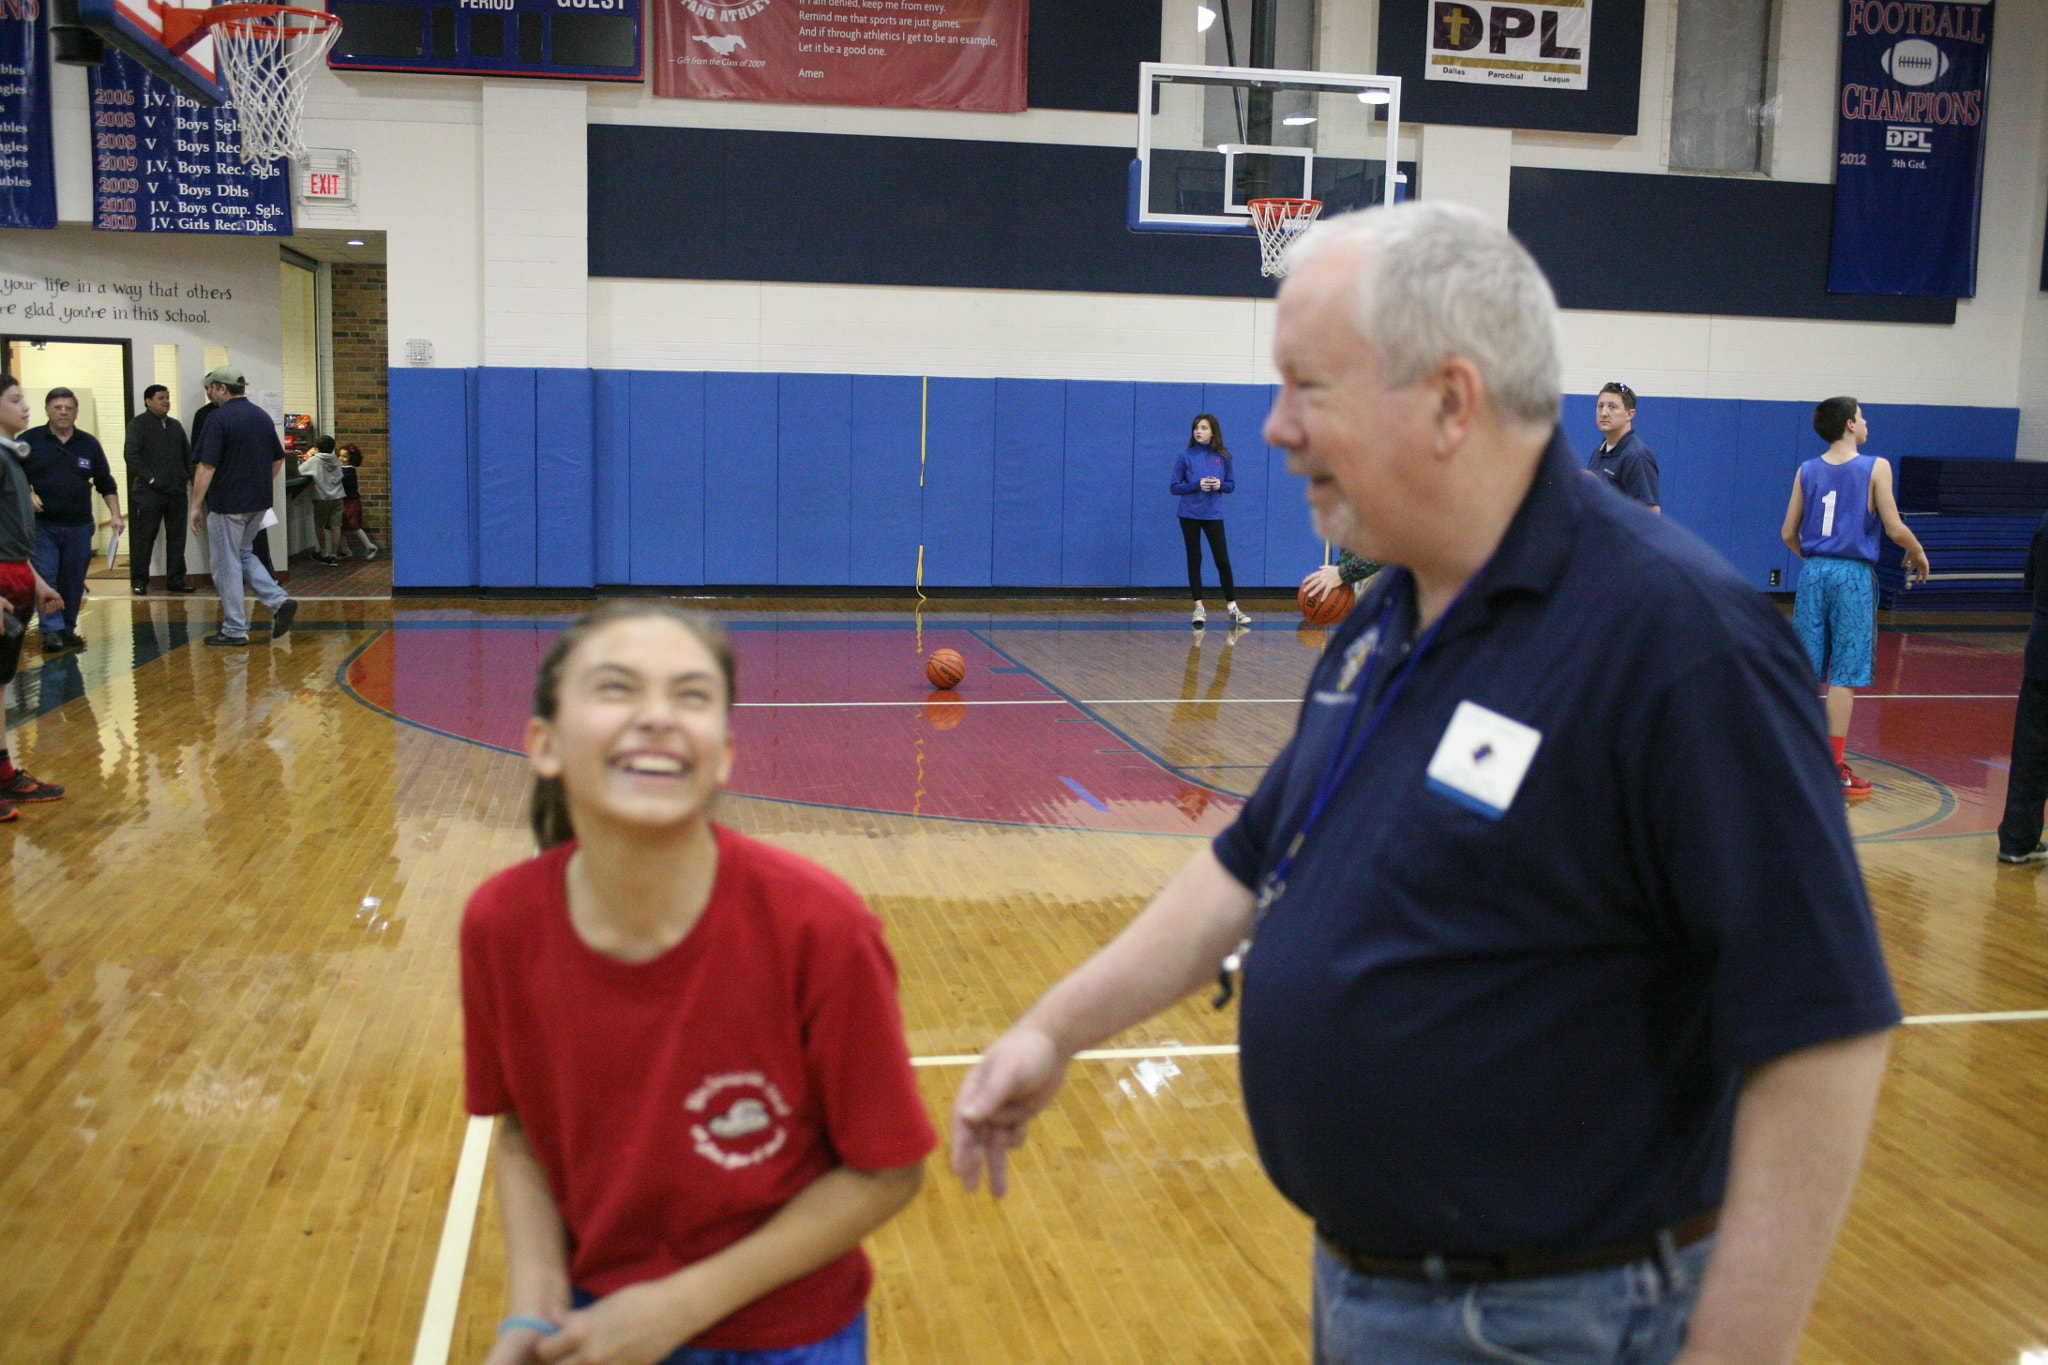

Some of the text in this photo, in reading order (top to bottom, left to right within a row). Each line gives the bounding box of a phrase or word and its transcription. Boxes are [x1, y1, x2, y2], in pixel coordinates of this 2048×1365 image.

[862, 0, 883, 11] keep
[886, 2, 899, 10] me
[901, 0, 922, 11] from
[924, 4, 946, 14] envy.
[799, 11, 832, 22] Remind
[835, 15, 848, 23] me
[850, 13, 868, 24] that
[870, 16, 897, 27] sports
[914, 17, 930, 29] just
[932, 20, 961, 30] games.
[1433, 1, 1581, 60] DPL
[1847, 1, 1986, 44] FOOTBALL
[799, 27, 817, 37] And
[819, 27, 826, 37] if
[827, 28, 861, 41] through
[863, 30, 900, 41] athletics
[908, 34, 921, 44] get
[924, 34, 933, 43] to
[936, 33, 946, 43] be
[960, 36, 998, 48] example,
[799, 42, 812, 52] Let
[815, 43, 821, 53] it
[824, 43, 835, 54] be
[844, 45, 866, 57] good
[868, 48, 886, 56] one.
[691, 57, 708, 65] from
[709, 57, 720, 66] the
[722, 58, 738, 67] Class
[739, 59, 748, 67] of
[799, 69, 824, 79] Amen
[1443, 67, 1571, 84] Dallas Parochial League
[0, 84, 28, 97] gles
[95, 90, 135, 105] 2006
[144, 95, 170, 109] J.V.
[176, 96, 208, 111] Boy
[1842, 83, 1981, 126] CHAMPIONS
[96, 112, 136, 128] 2008
[144, 116, 157, 128] V
[176, 118, 209, 134] Boys
[97, 134, 137, 150] 2008
[145, 139, 157, 150] V
[177, 140, 210, 156] Boys
[1886, 131, 1932, 148] DPL
[99, 156, 280, 180] 2009 J.V. Boys Rec. Sgls
[1840, 153, 1867, 166] 2012
[1892, 159, 1927, 169] 5th Grd.
[100, 178, 249, 199] 2009 V Boys Dbls
[311, 174, 340, 195] EXIT
[100, 197, 284, 219] 2010 J.V. Boys Comp. Sgls.
[100, 215, 277, 232] 2010 J.V. Girls Rec. Dbls.
[0, 277, 232, 302] your life in a way that others
[25, 302, 55, 319] glad
[59, 306, 107, 324] you're
[113, 307, 128, 320] in
[133, 305, 159, 321] this
[1822, 491, 1837, 537] 1
